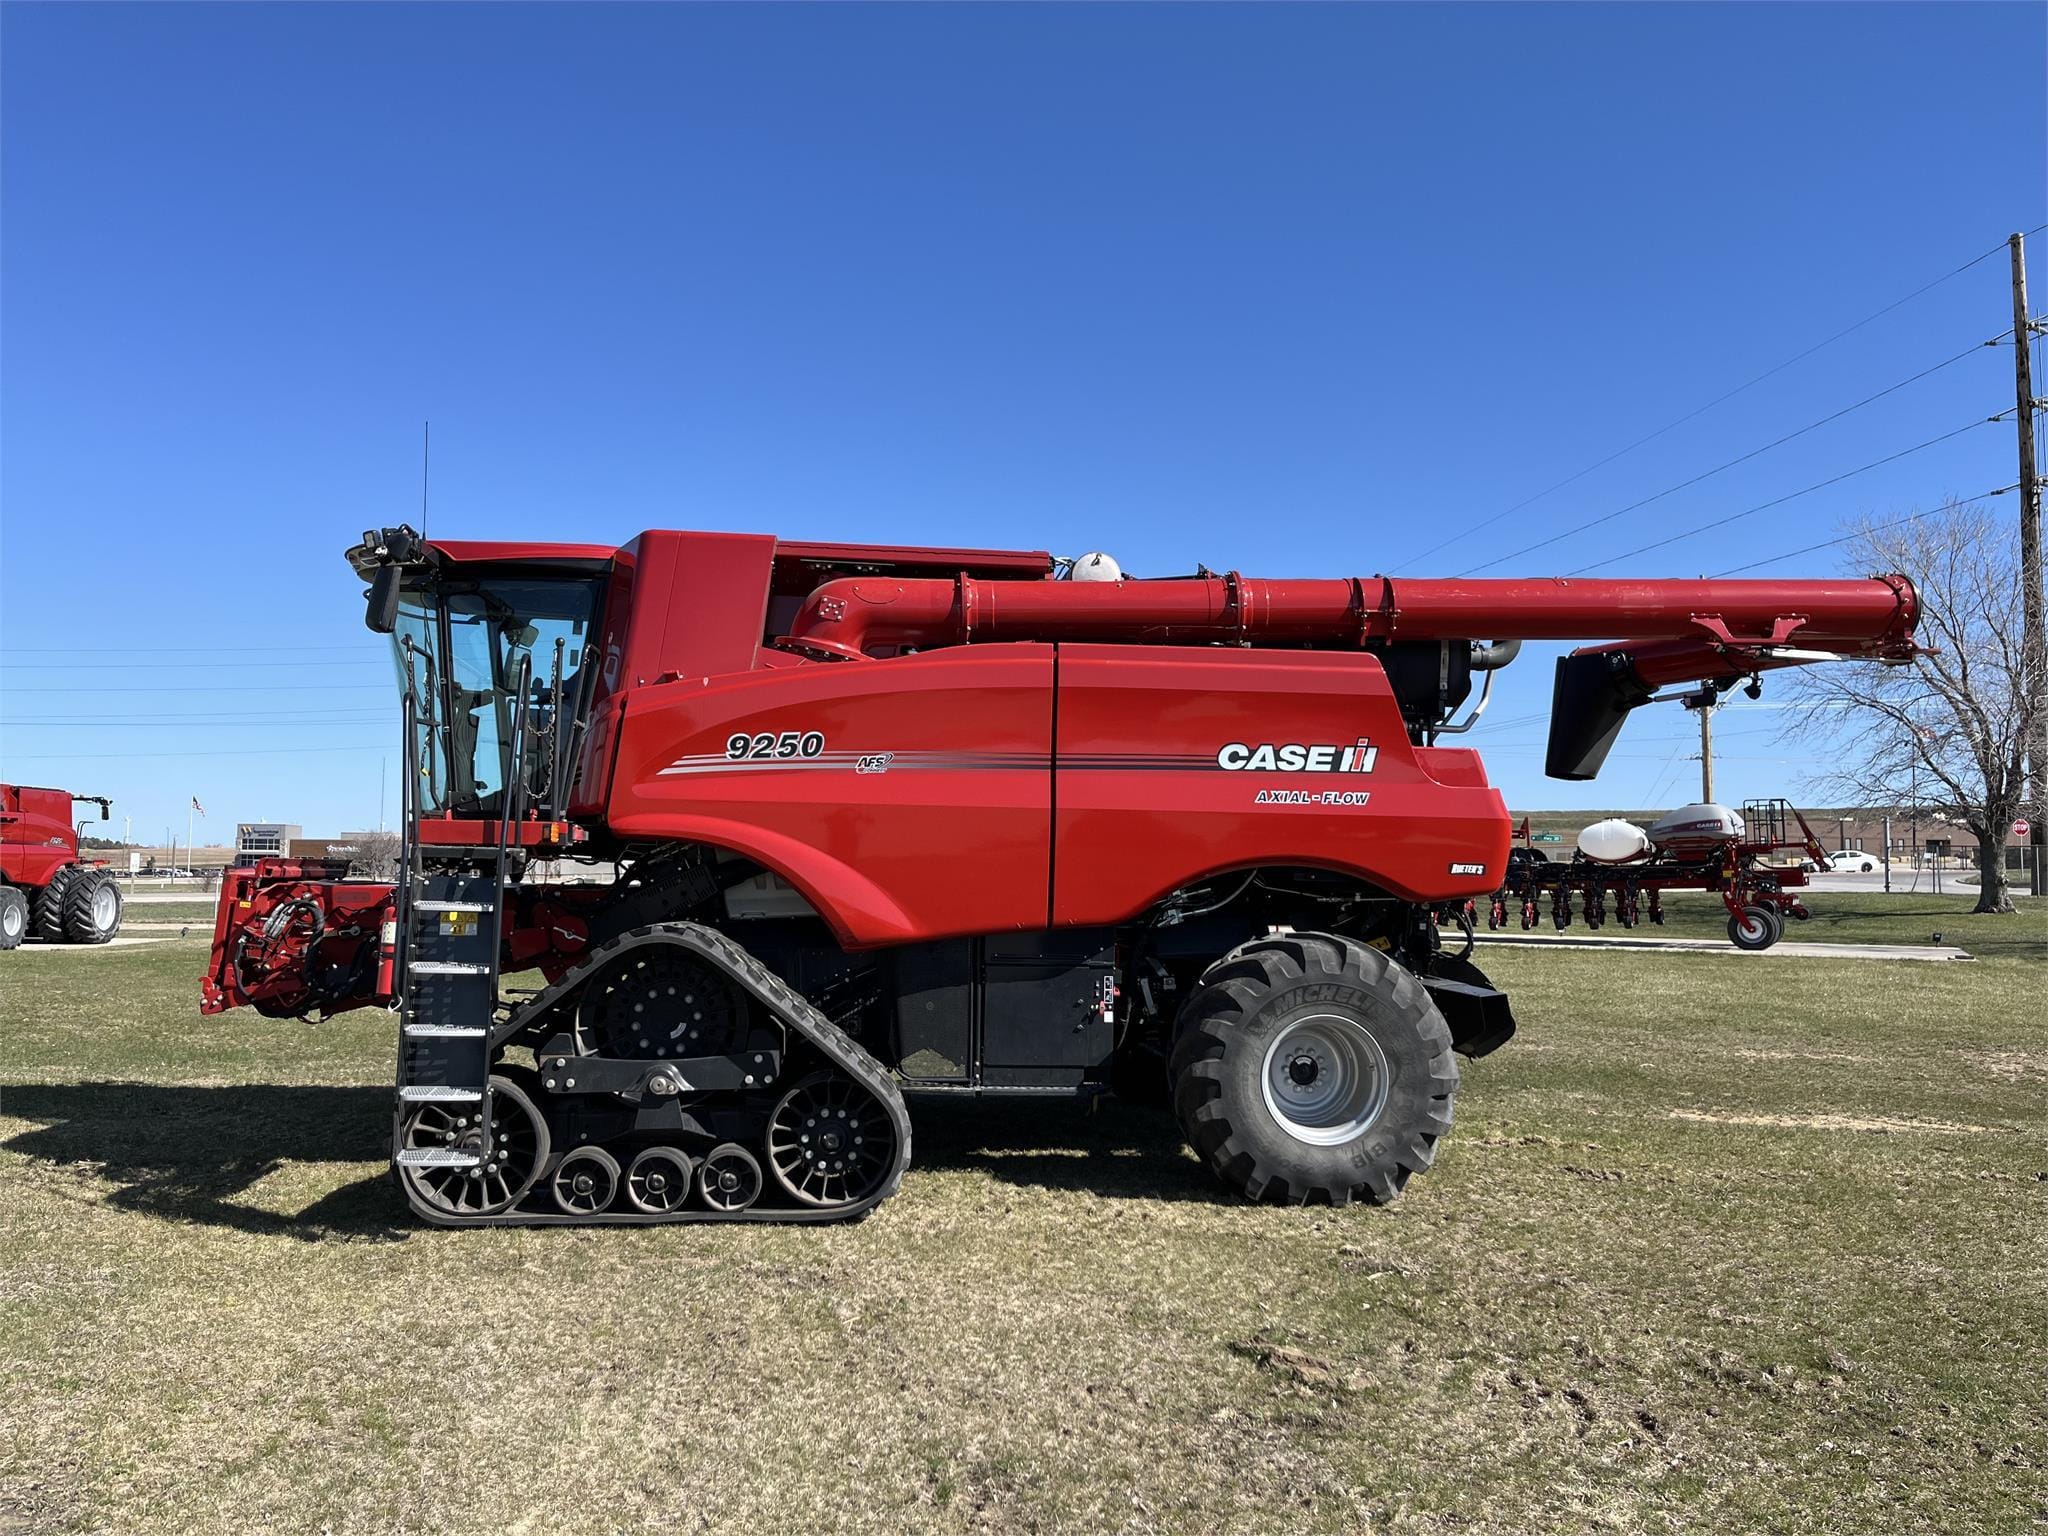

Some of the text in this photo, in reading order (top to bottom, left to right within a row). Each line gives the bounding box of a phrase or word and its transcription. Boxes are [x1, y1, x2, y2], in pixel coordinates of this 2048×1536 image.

[726, 731, 825, 760] 9250
[856, 755, 885, 768] AFS
[1217, 743, 1336, 772] CASE
[1255, 790, 1370, 806] AXIAL-FLOW
[1451, 863, 1484, 875] RUETER'S
